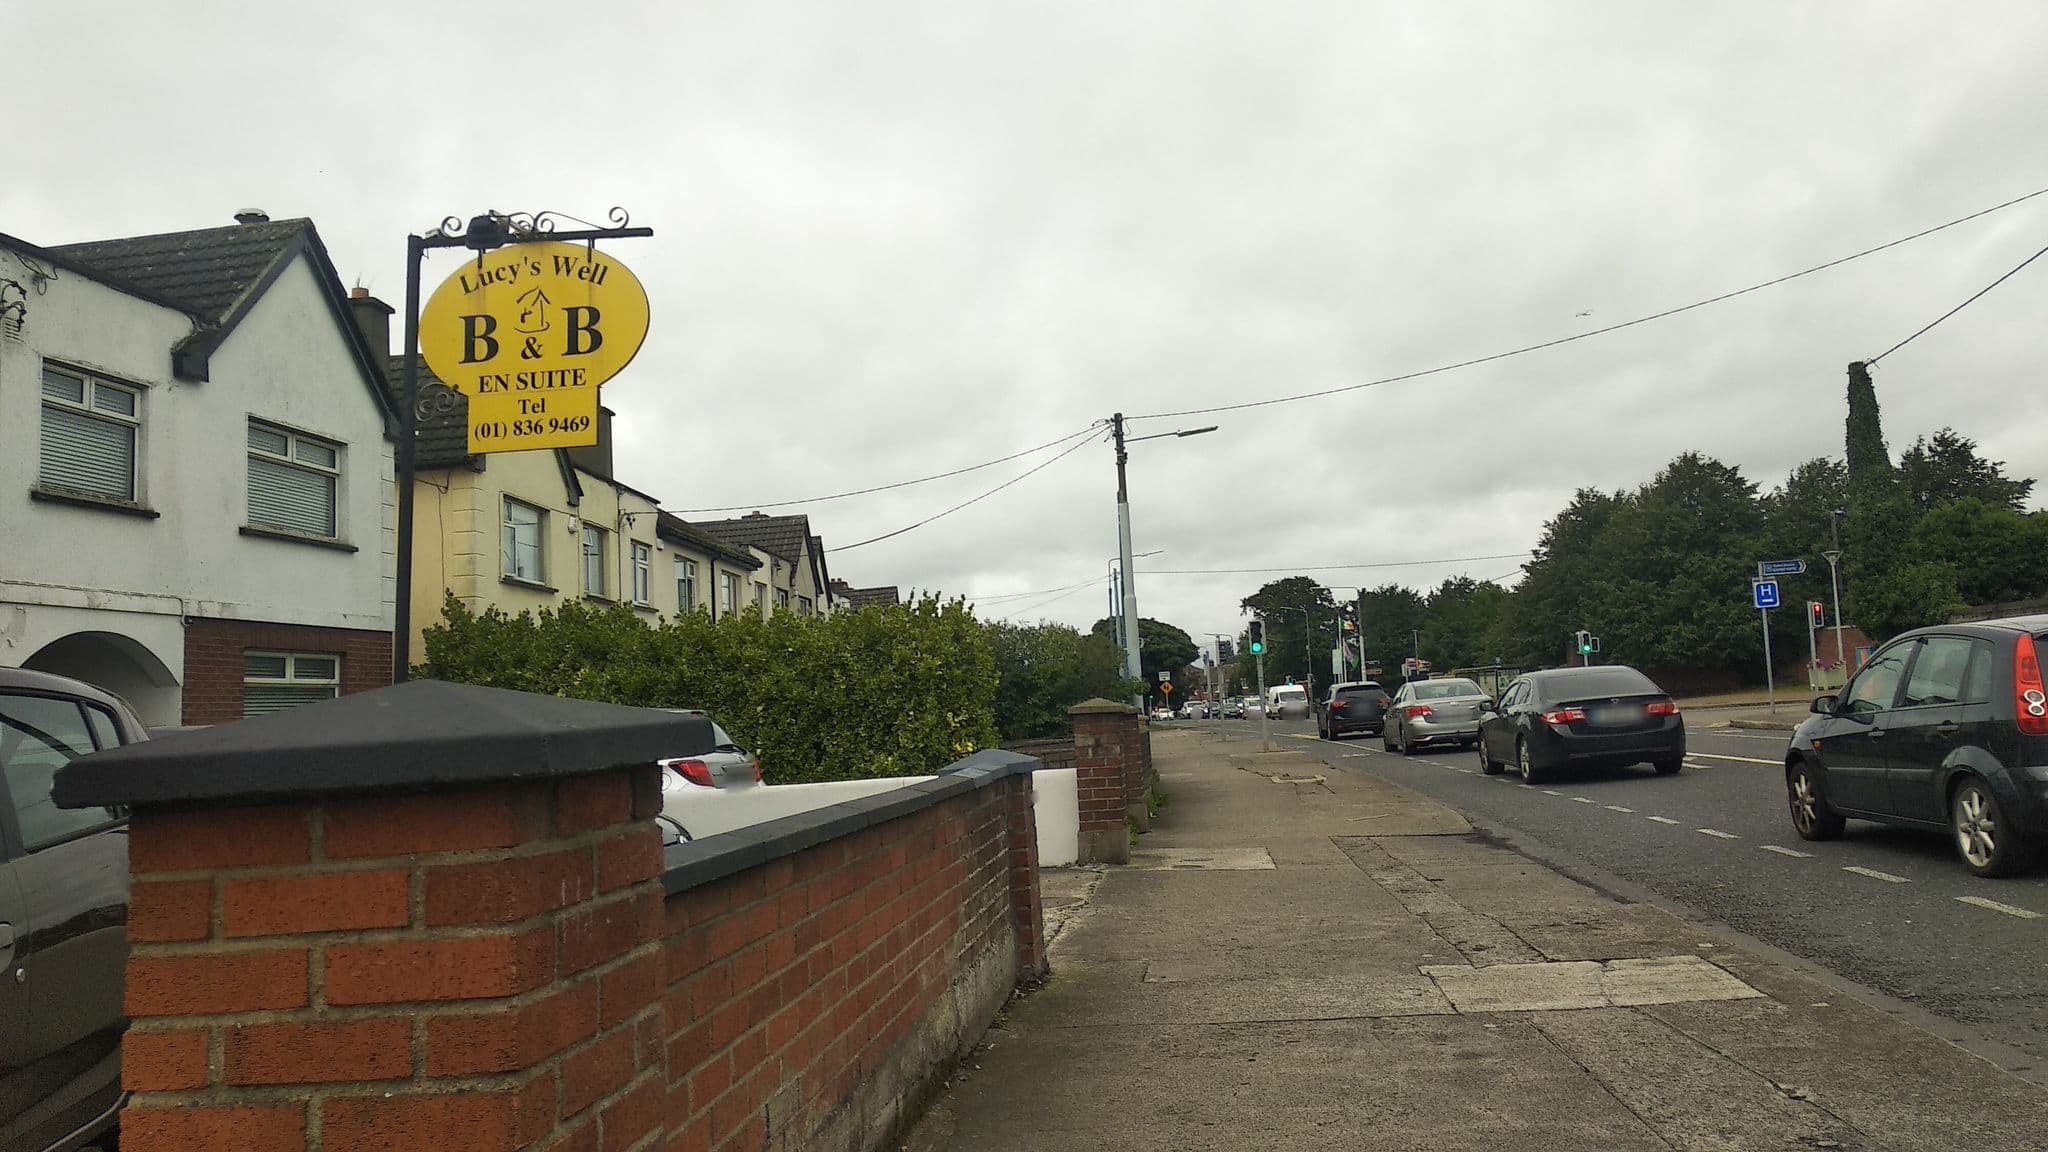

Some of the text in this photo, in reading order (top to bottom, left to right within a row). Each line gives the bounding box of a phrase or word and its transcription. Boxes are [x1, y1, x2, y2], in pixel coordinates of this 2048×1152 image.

[459, 255, 609, 296] Lucy's Well
[458, 306, 603, 364] B & B
[478, 368, 587, 393] EN SUITE
[518, 398, 546, 414] Tel
[474, 415, 590, 441] (01) 836 9469
